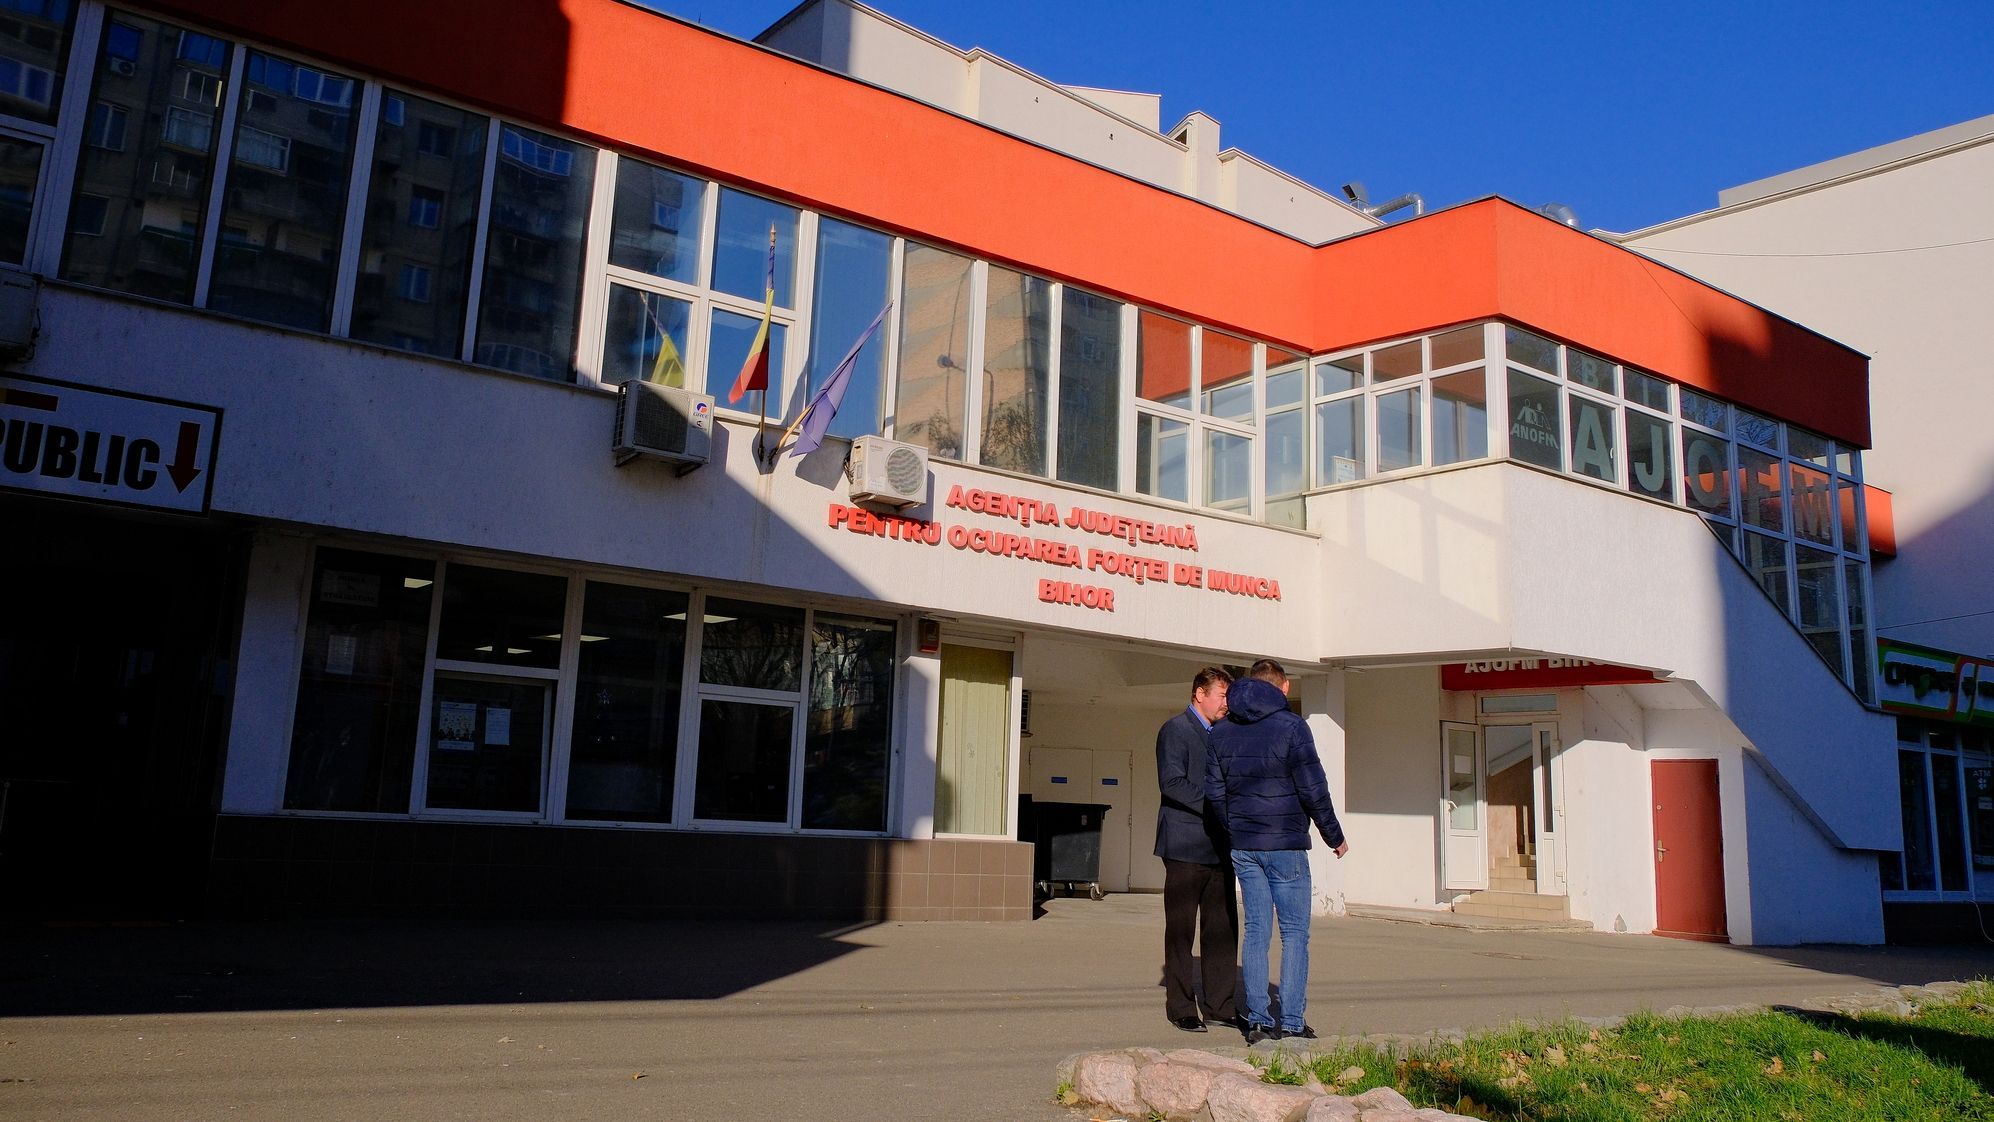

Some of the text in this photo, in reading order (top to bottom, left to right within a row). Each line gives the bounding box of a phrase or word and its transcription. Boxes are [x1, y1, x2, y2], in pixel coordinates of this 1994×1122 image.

[0, 419, 160, 490] UBLIC
[1510, 422, 1559, 450] ANOFM
[828, 504, 942, 546] PENTRU
[946, 525, 1083, 570] OCUPAREA
[1174, 563, 1203, 589] DE
[1038, 579, 1115, 613] BIHOR
